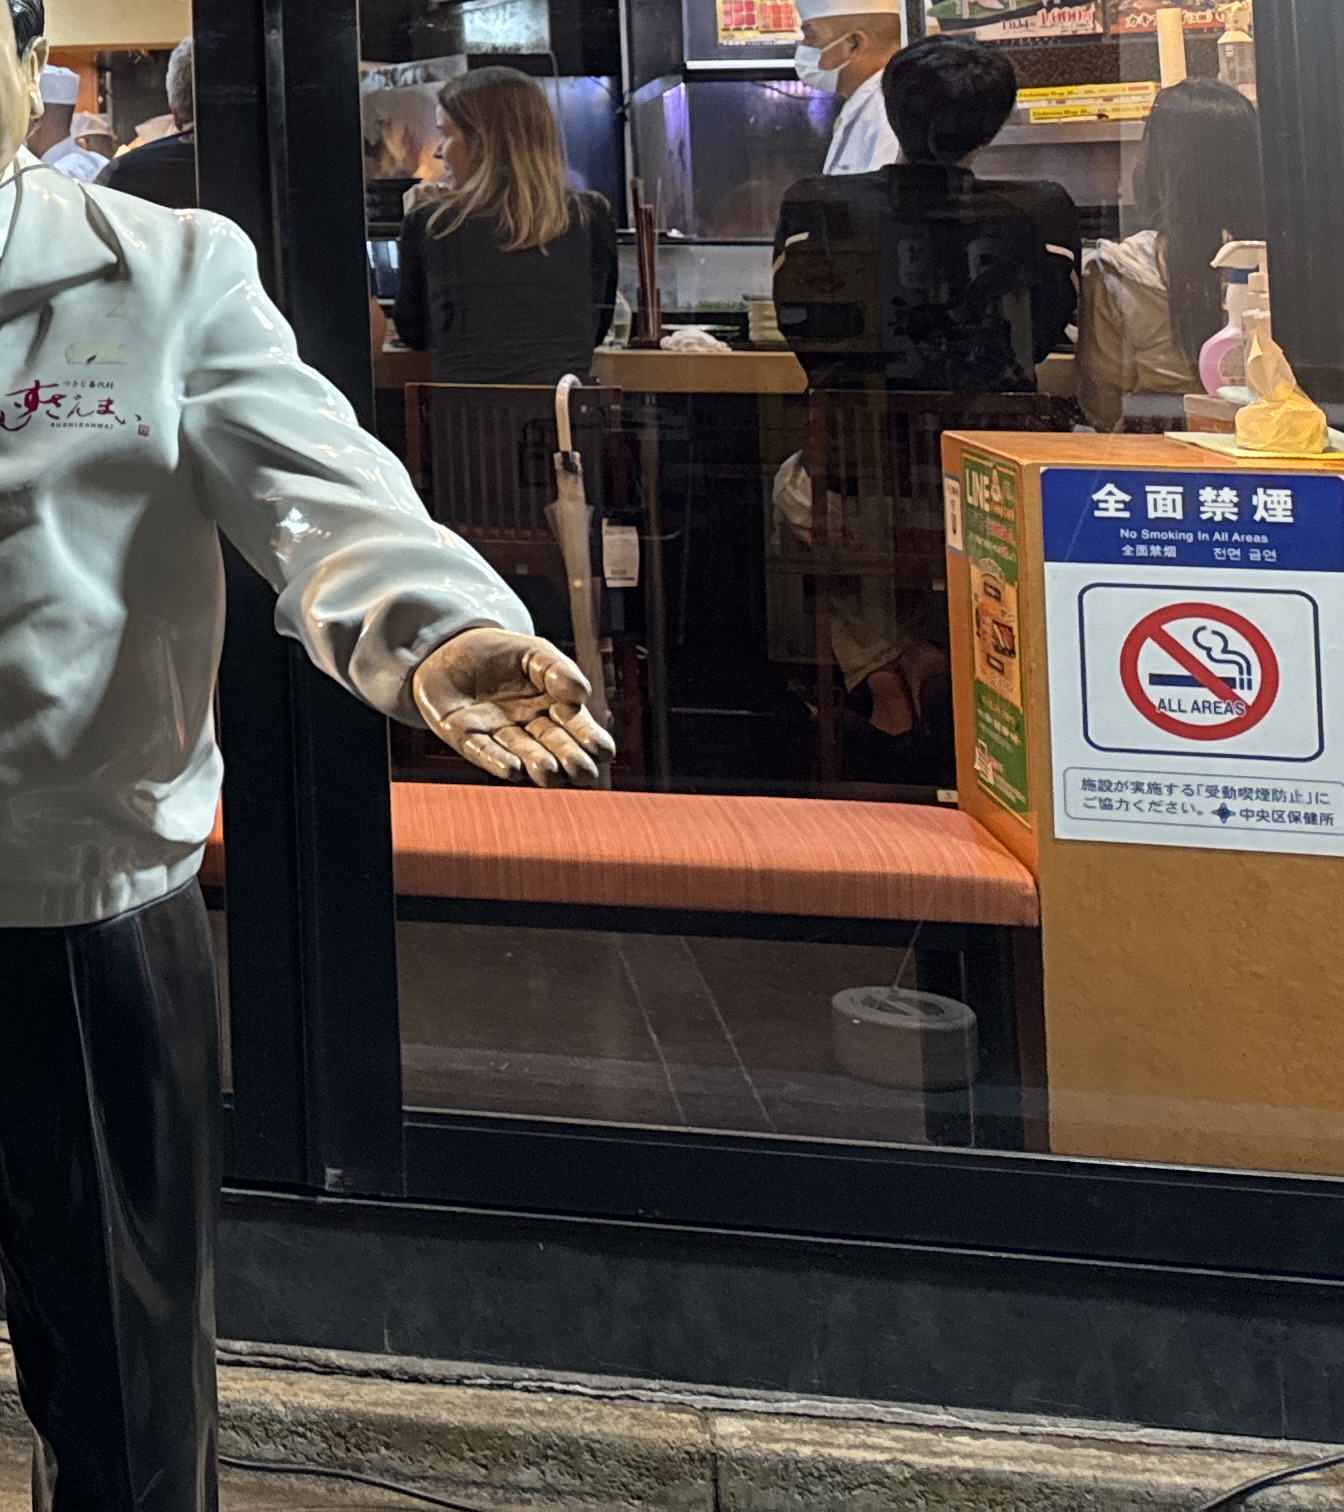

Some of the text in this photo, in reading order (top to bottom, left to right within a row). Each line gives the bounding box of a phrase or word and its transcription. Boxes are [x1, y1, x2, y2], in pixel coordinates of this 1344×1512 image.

[50, 422, 114, 430] SUSHIZANMAI
[965, 466, 990, 513] LINE
[1091, 483, 1294, 524] 全面禁煙
[1120, 528, 1269, 544] No Smoking In All Areas
[1121, 544, 1177, 558] 全面禁烟
[1249, 548, 1277, 562] 금연
[1157, 698, 1246, 716] ALL AREAS
[1081, 777, 1331, 805] 施設が実施する「受動喫煙防止」に
[1083, 796, 1203, 816] ご協力ください。
[1240, 808, 1334, 826] 中央区保健所
